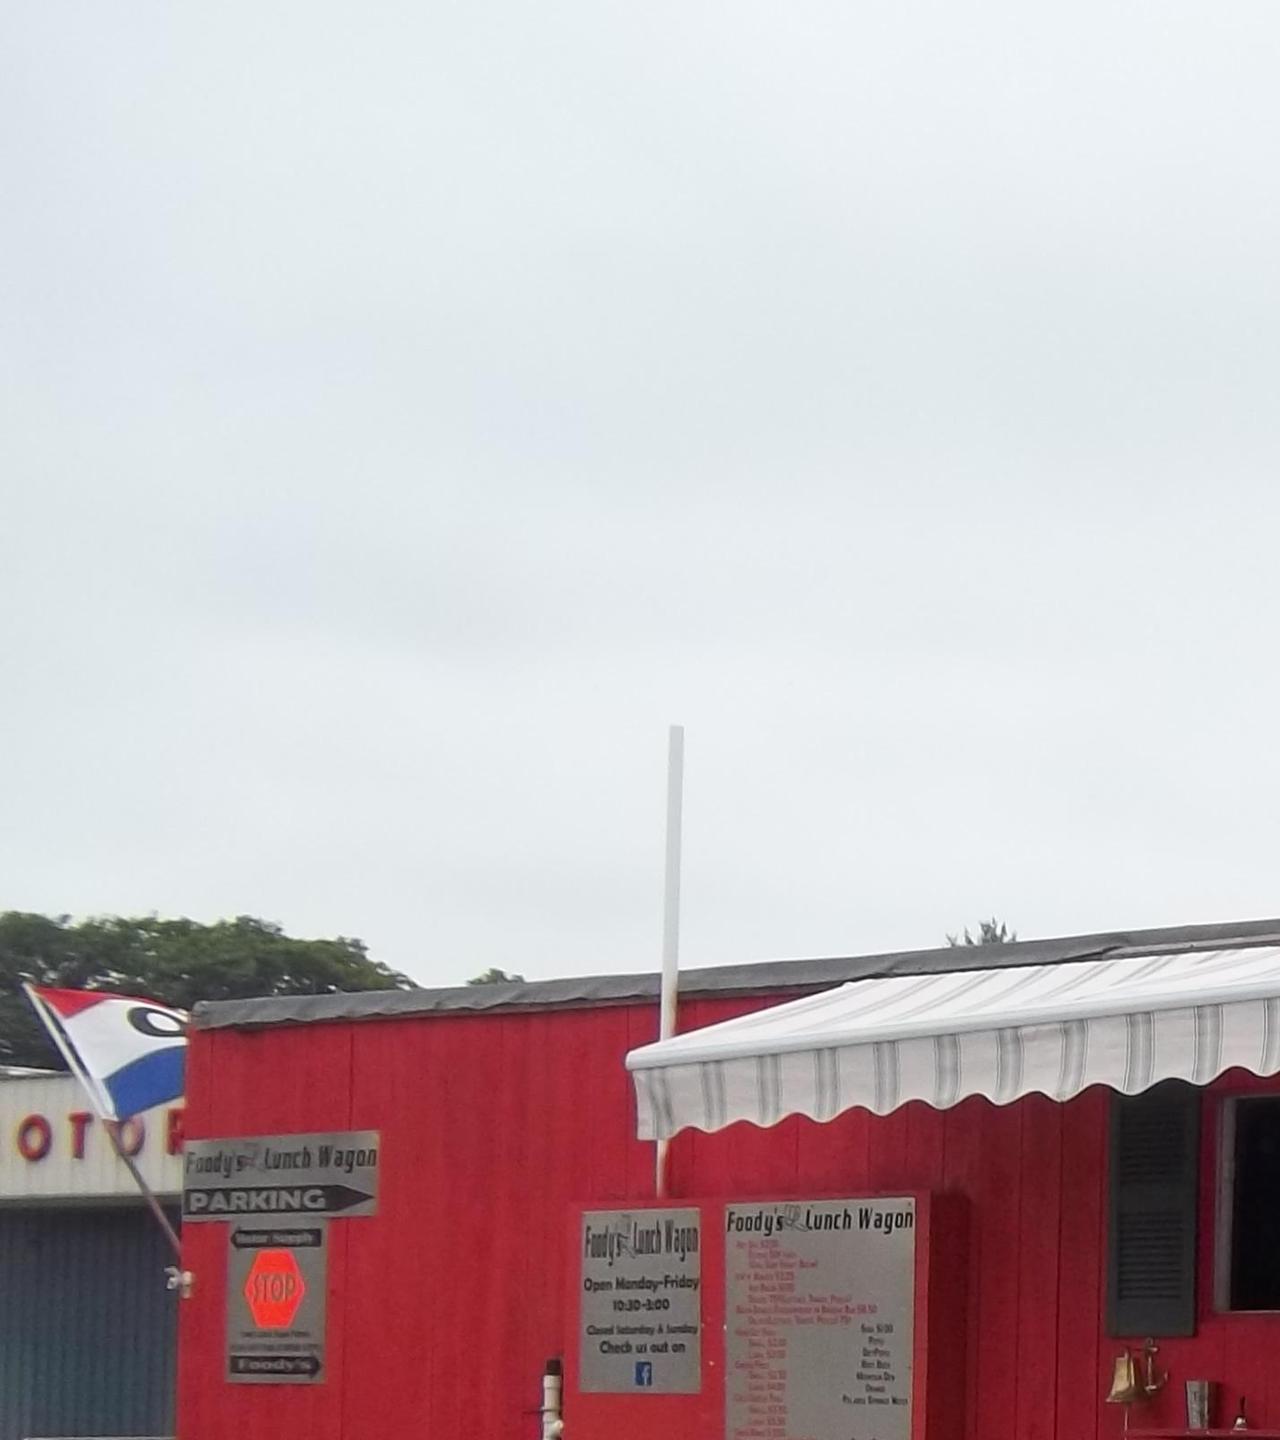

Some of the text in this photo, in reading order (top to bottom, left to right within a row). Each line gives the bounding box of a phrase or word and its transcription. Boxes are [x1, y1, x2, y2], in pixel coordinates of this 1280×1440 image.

[185, 1145, 377, 1178] Foody's Lunch Wagon
[190, 1189, 325, 1212] PARKING
[727, 1207, 913, 1236] Foody's Lunch Wagon
[254, 1273, 296, 1302] STOP
[584, 1277, 612, 1293] Open
[599, 1340, 685, 1354] Check us out on
